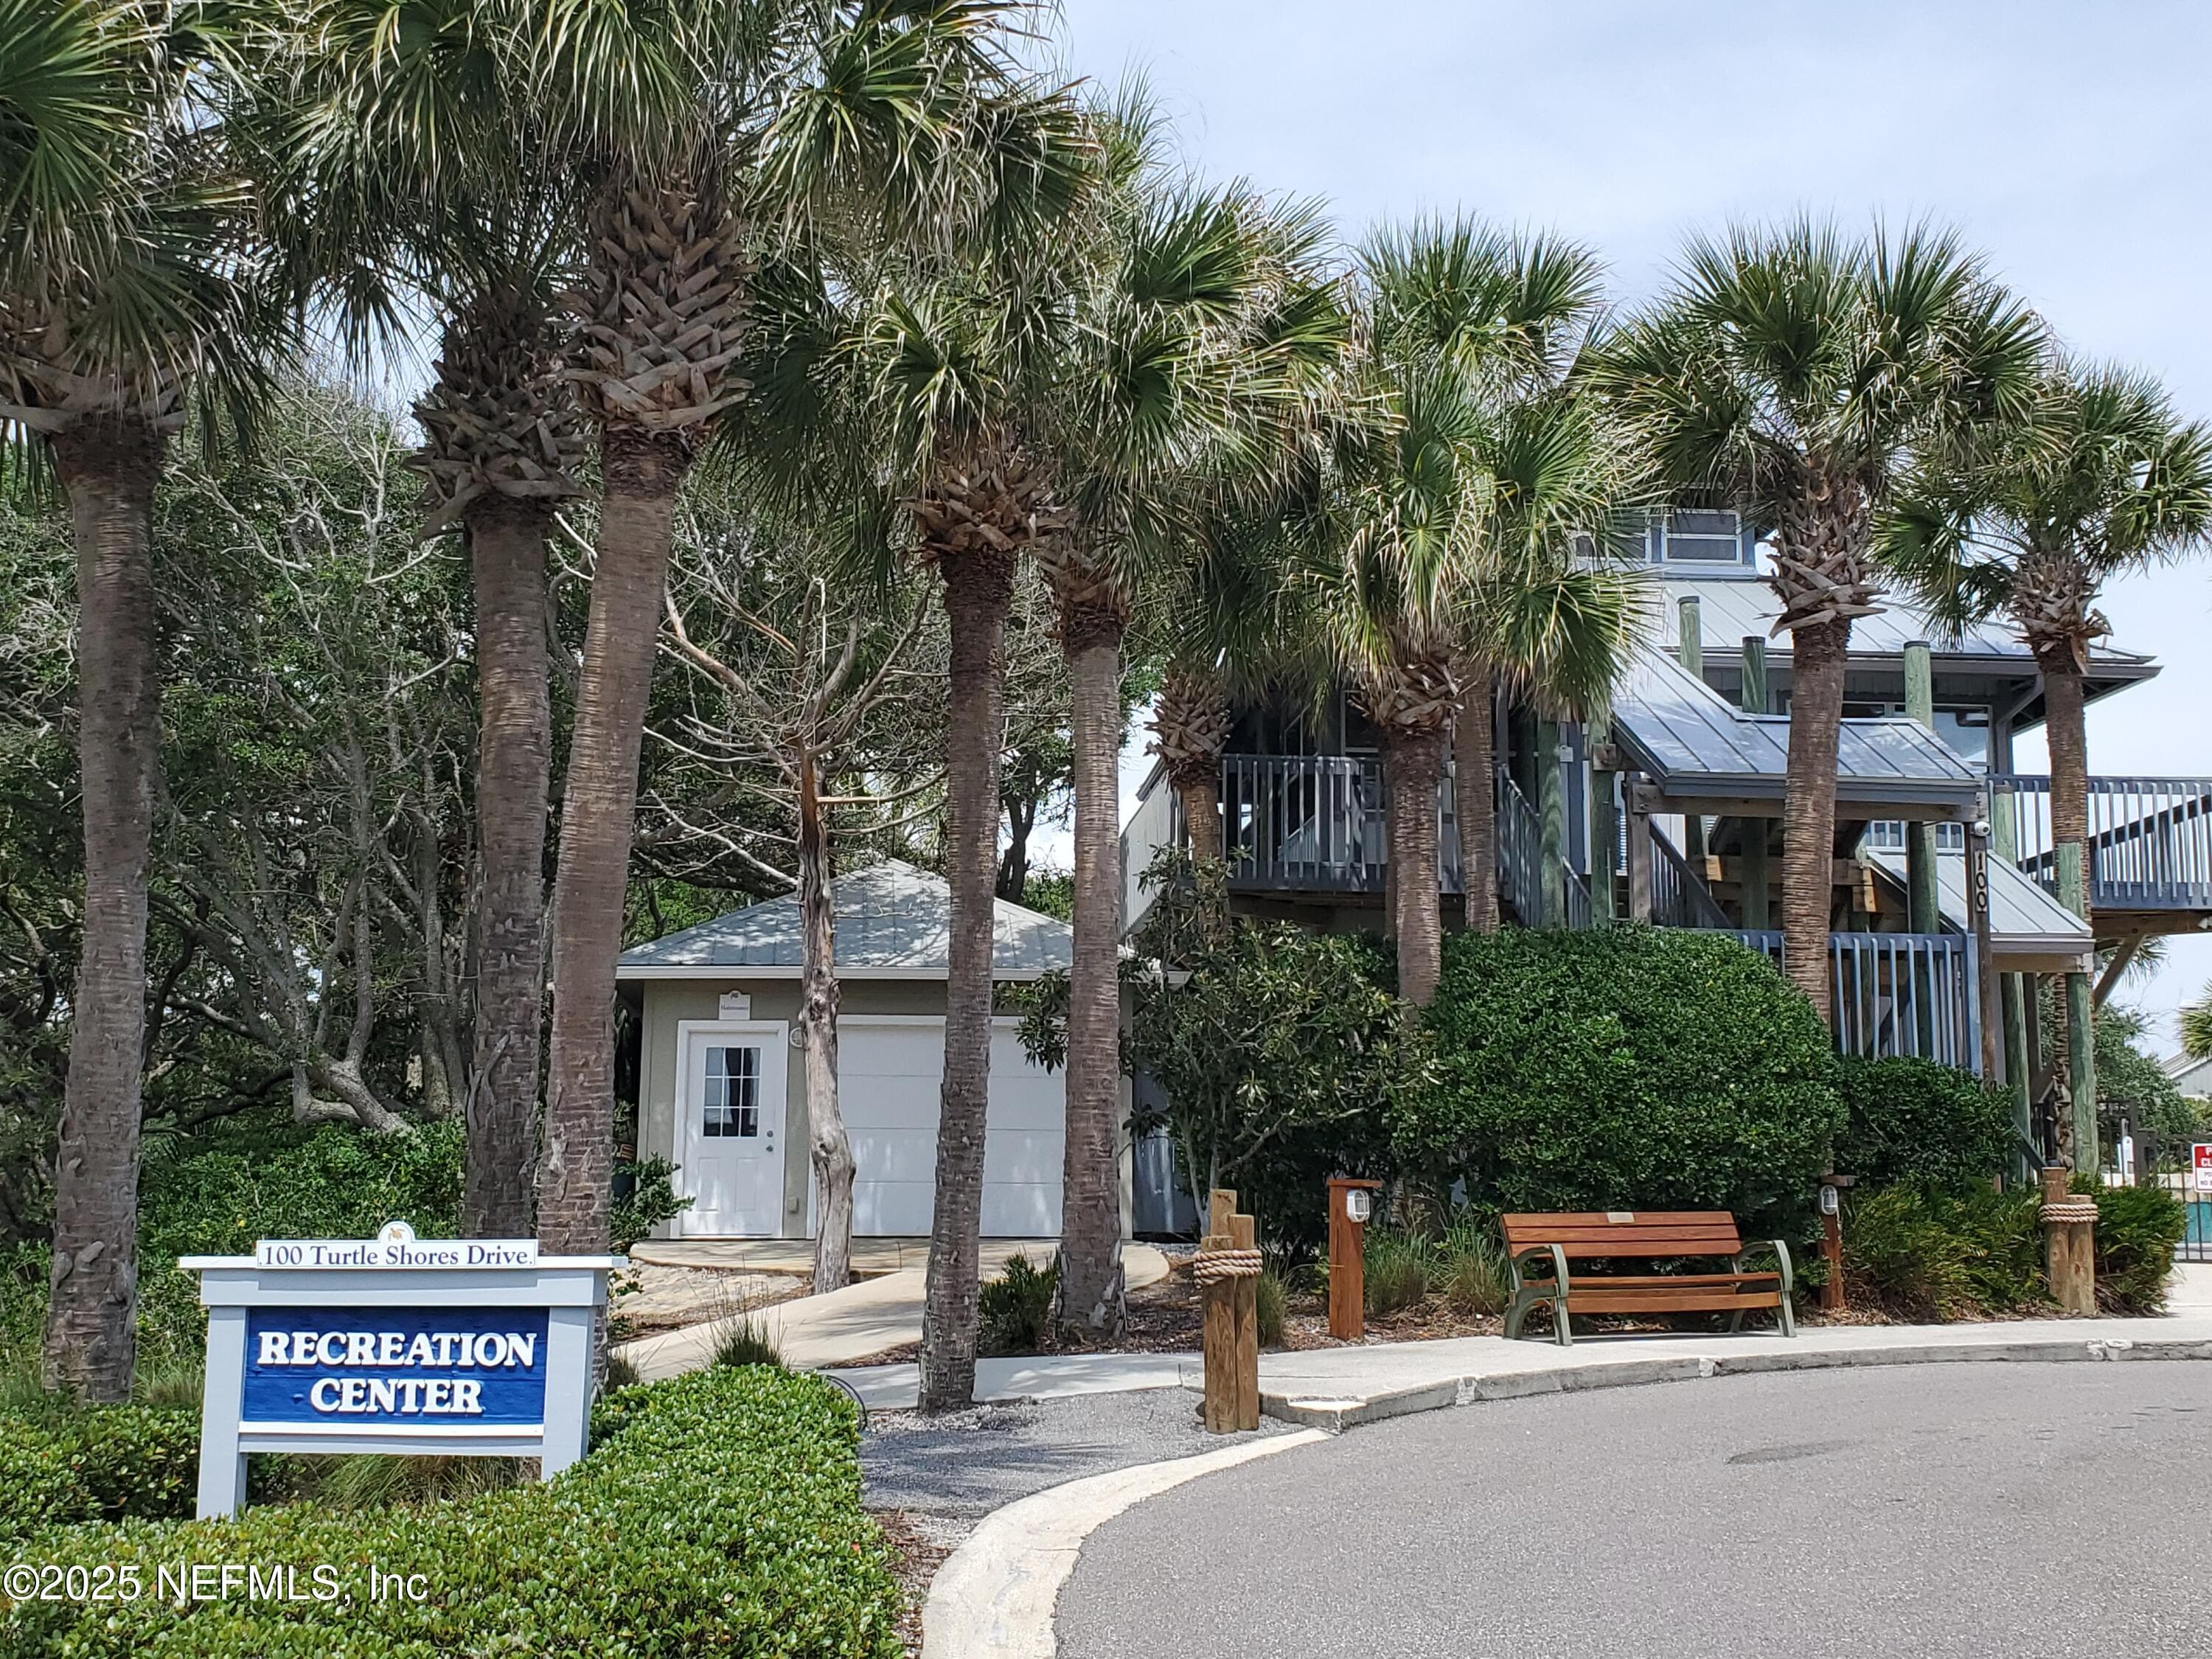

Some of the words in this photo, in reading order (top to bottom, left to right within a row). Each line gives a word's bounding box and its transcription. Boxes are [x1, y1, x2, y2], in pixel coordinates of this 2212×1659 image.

[1975, 852, 1987, 908] 100
[265, 1245, 303, 1265] 100
[310, 1245, 378, 1265] Turtle
[386, 1245, 459, 1265] Shores
[467, 1245, 529, 1265] Drive
[256, 1331, 538, 1367] RECREATION
[310, 1377, 484, 1413] CENTER
